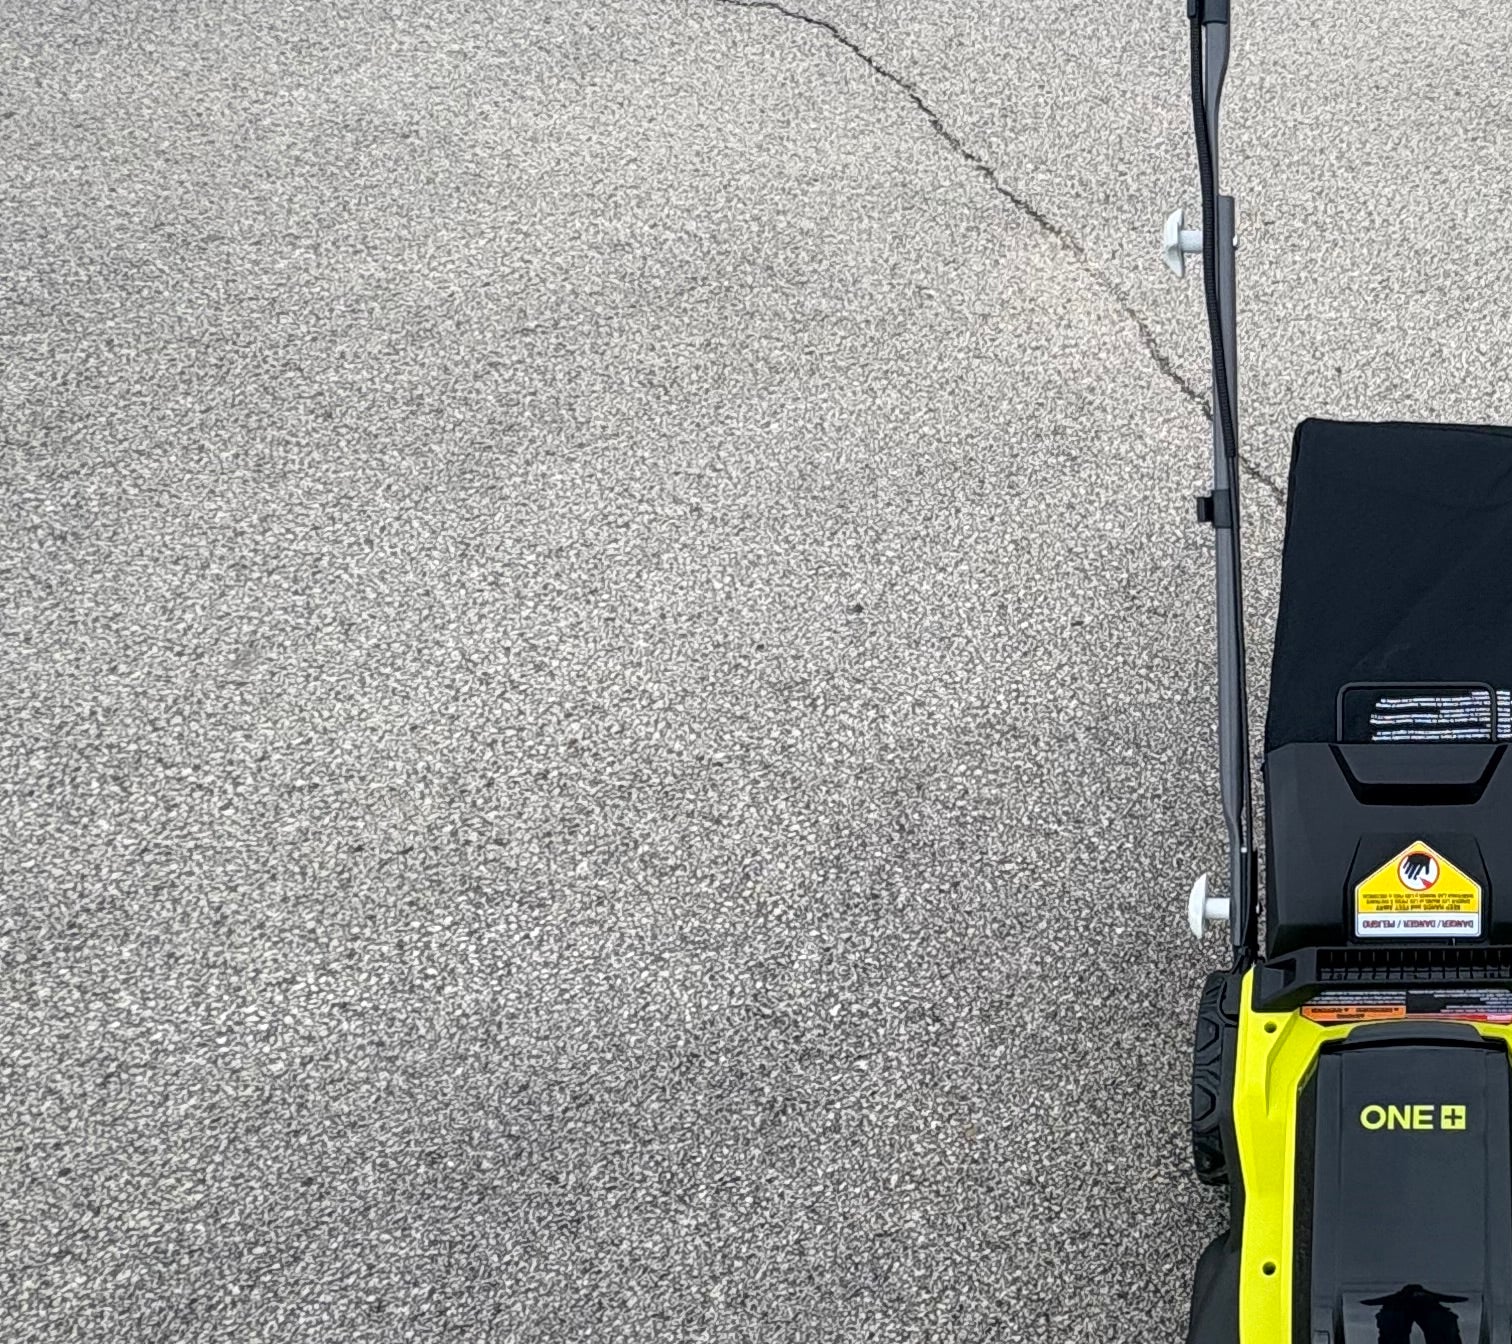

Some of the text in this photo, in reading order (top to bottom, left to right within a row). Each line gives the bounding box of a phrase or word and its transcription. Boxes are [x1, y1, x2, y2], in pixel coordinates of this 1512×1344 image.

[1363, 919, 1395, 929] PELIGRO
[1404, 920, 1436, 929] DANGER
[1442, 920, 1474, 929] DANGER
[1360, 1105, 1435, 1130] ONE
